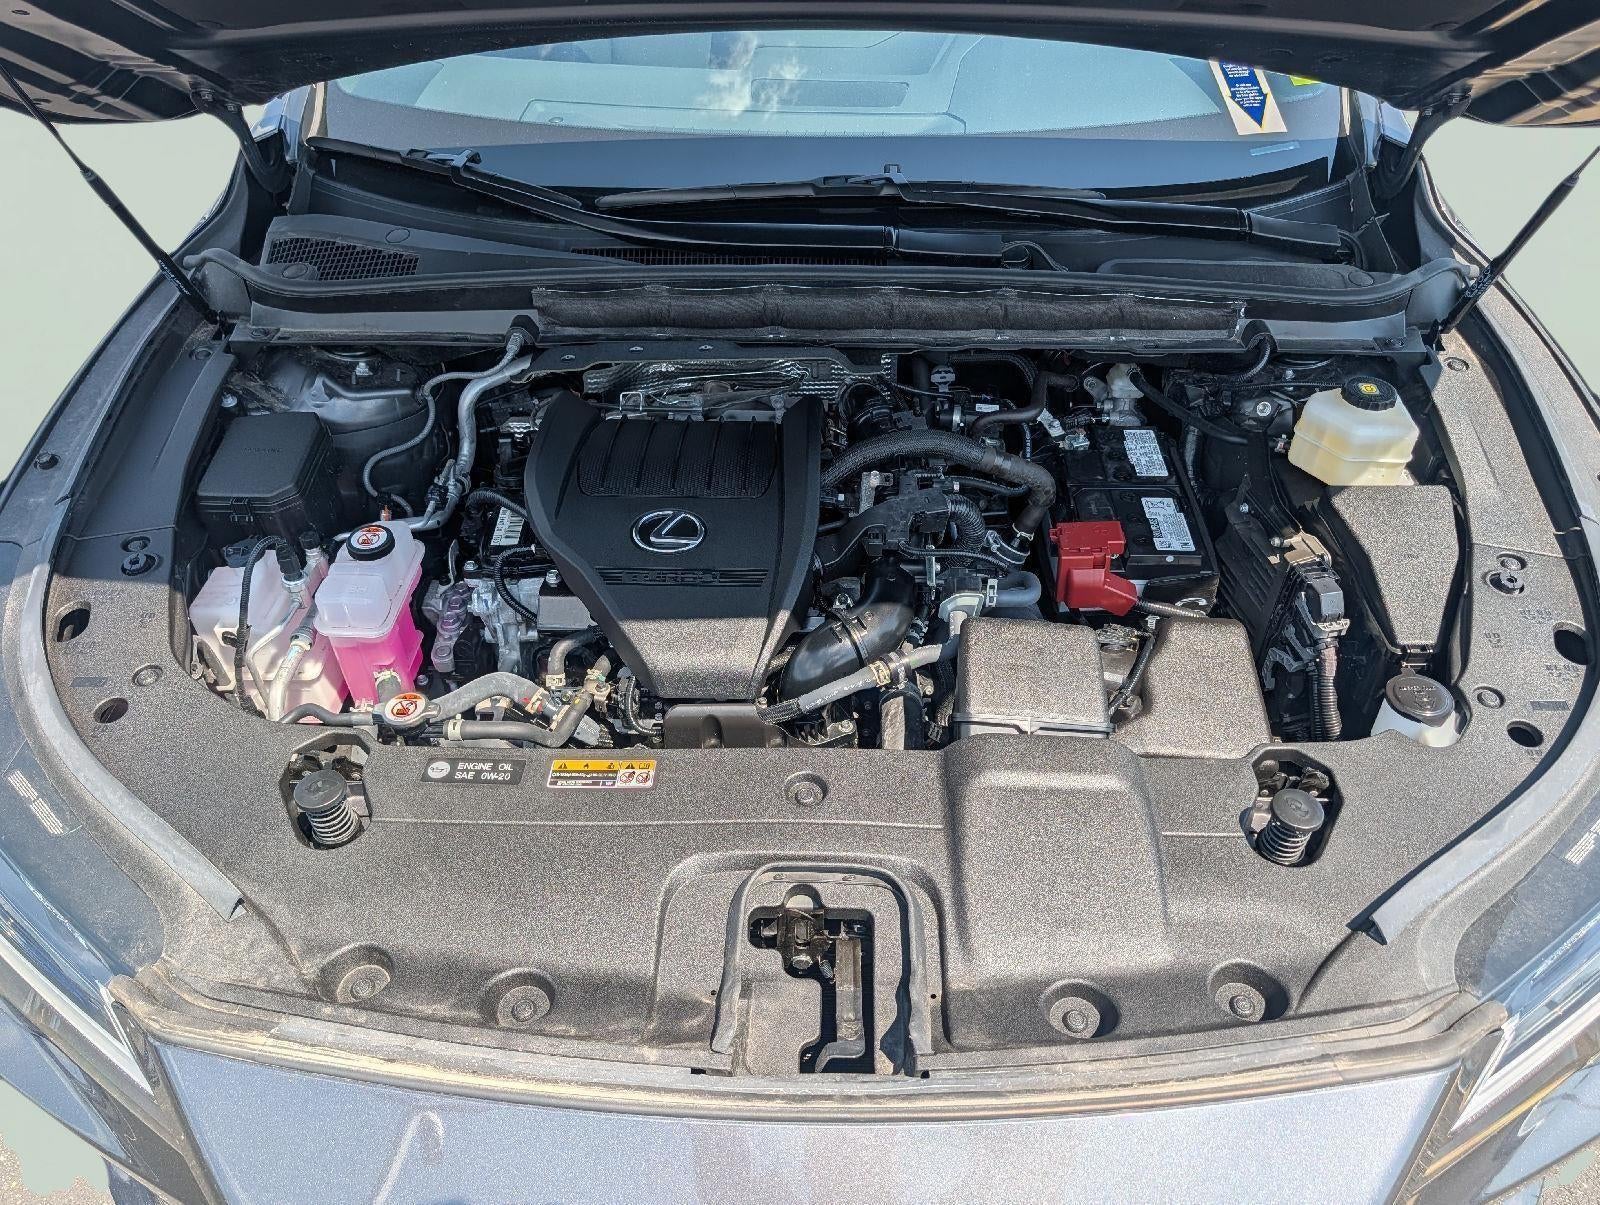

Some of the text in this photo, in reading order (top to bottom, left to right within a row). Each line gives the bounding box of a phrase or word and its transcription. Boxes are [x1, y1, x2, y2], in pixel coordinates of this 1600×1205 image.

[457, 762, 514, 771] ENGINE OIL
[454, 771, 511, 781] SAE 0W-20
